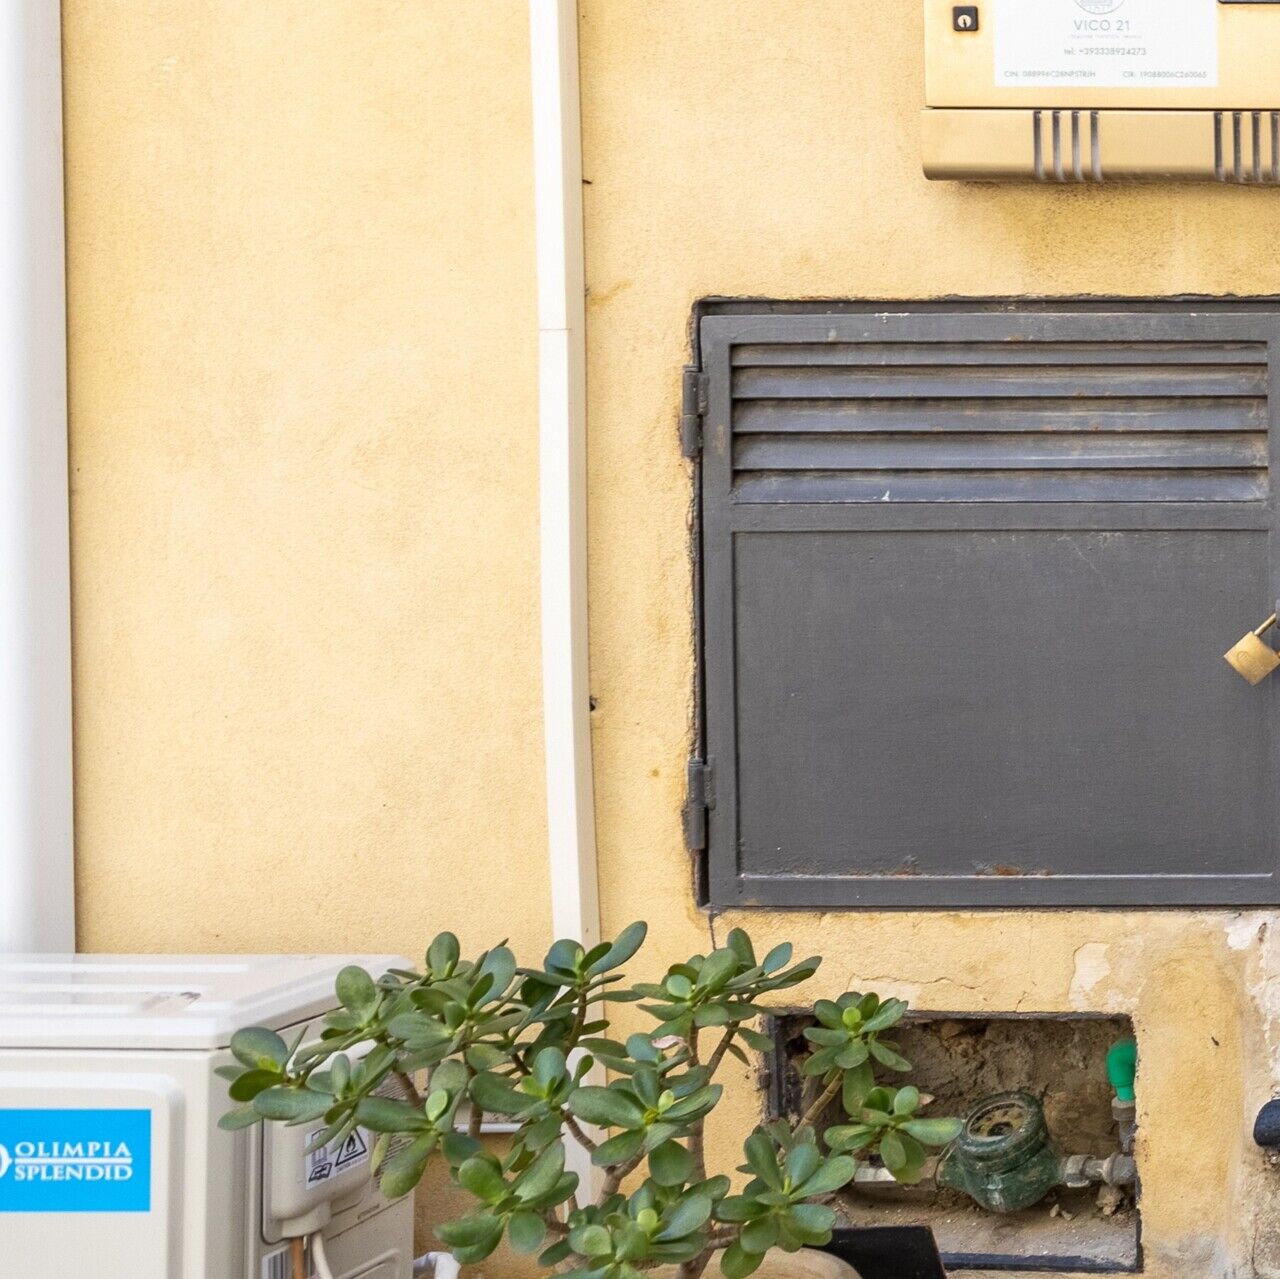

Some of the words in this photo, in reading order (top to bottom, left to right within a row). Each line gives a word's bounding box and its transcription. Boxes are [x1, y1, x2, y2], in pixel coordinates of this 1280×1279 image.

[1073, 19, 1111, 31] VICO
[1116, 19, 1130, 31] 21
[14, 1141, 132, 1157] OLIMPIA
[14, 1164, 133, 1181] SPLENDID
